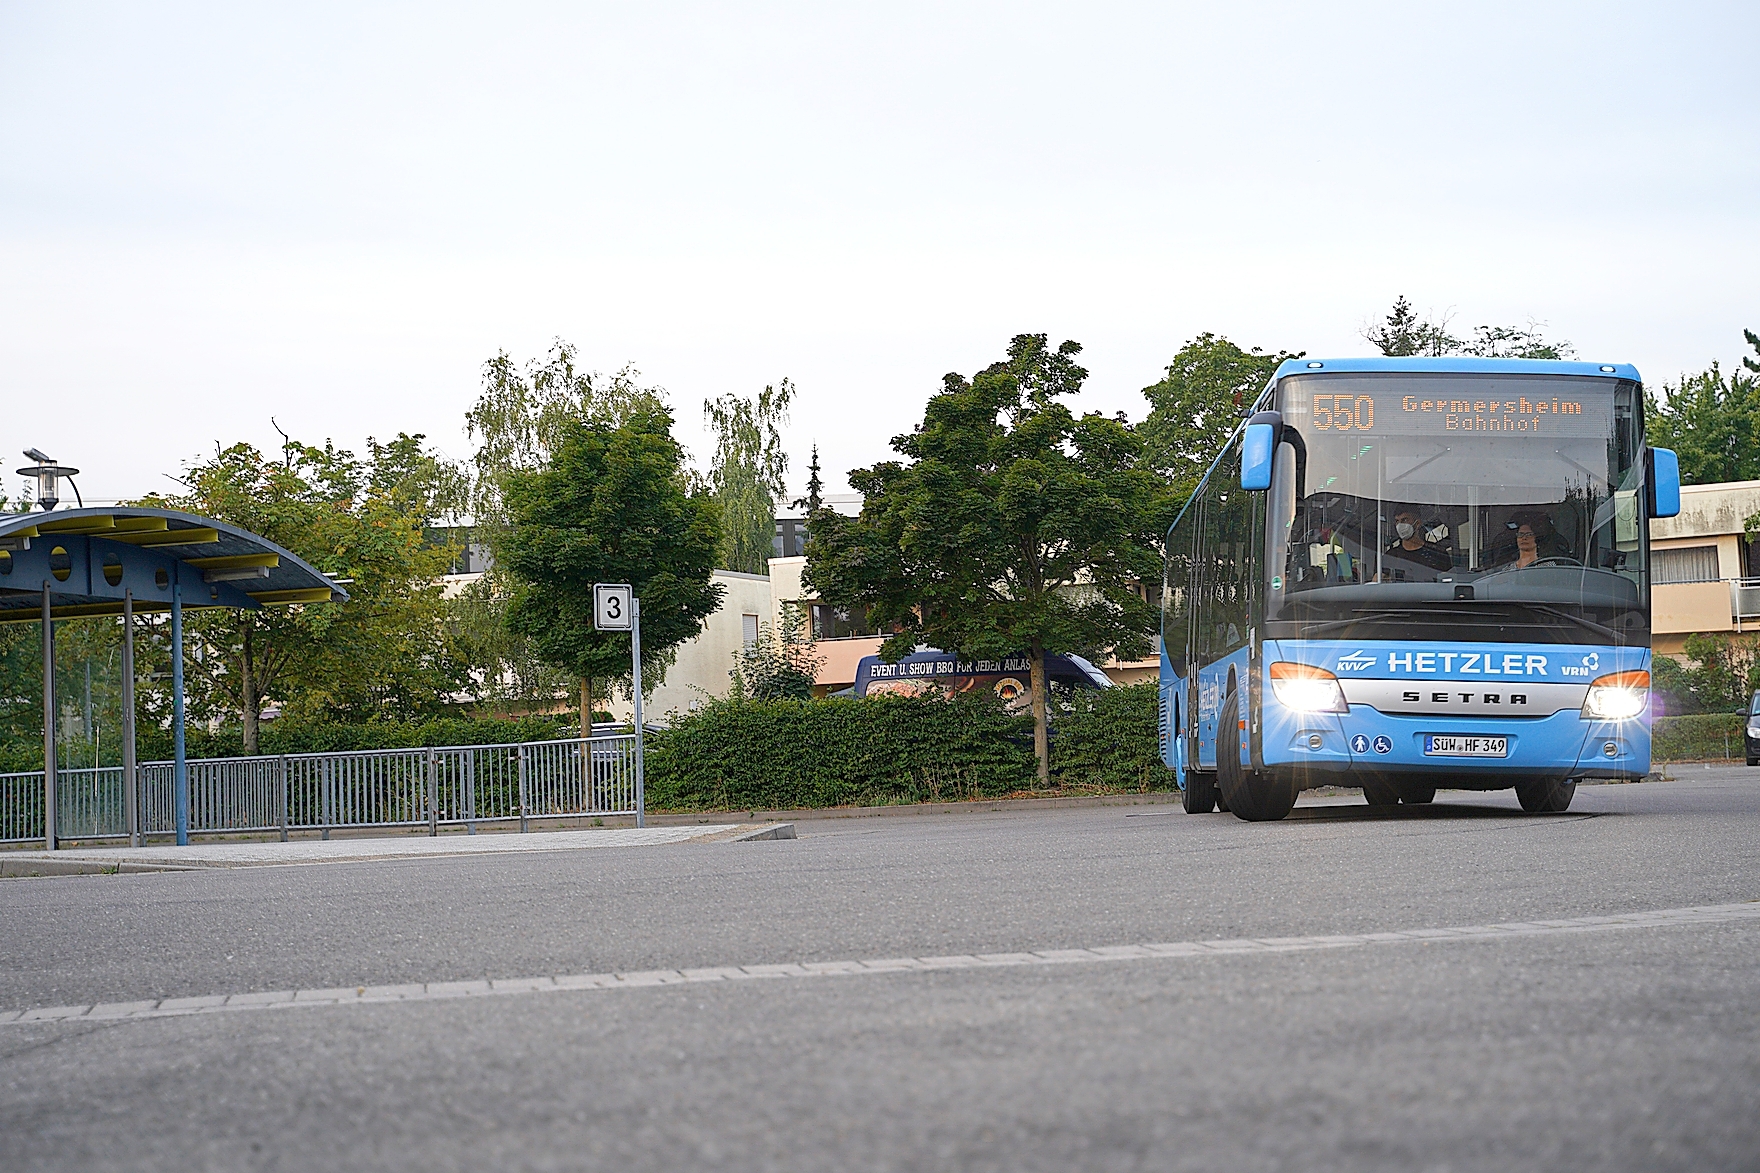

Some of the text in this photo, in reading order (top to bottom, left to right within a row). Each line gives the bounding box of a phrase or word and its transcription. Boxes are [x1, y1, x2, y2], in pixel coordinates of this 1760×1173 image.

[1313, 394, 1374, 431] 550
[1402, 395, 1582, 415] Germersheim
[1445, 413, 1541, 432] Bahnhof
[606, 595, 622, 619] 3
[870, 664, 897, 677] EVENT
[899, 663, 907, 676] U.
[909, 662, 935, 676] SHOW
[936, 661, 954, 674] BBQ
[975, 659, 1001, 672] JEDEN
[1003, 658, 1032, 671] ANLAS
[1336, 661, 1362, 671] KVV
[1387, 652, 1548, 677] HETZLER
[1561, 666, 1589, 677] VRN
[1402, 691, 1528, 705] SETRA
[1433, 737, 1505, 753] SÜW HF 349
